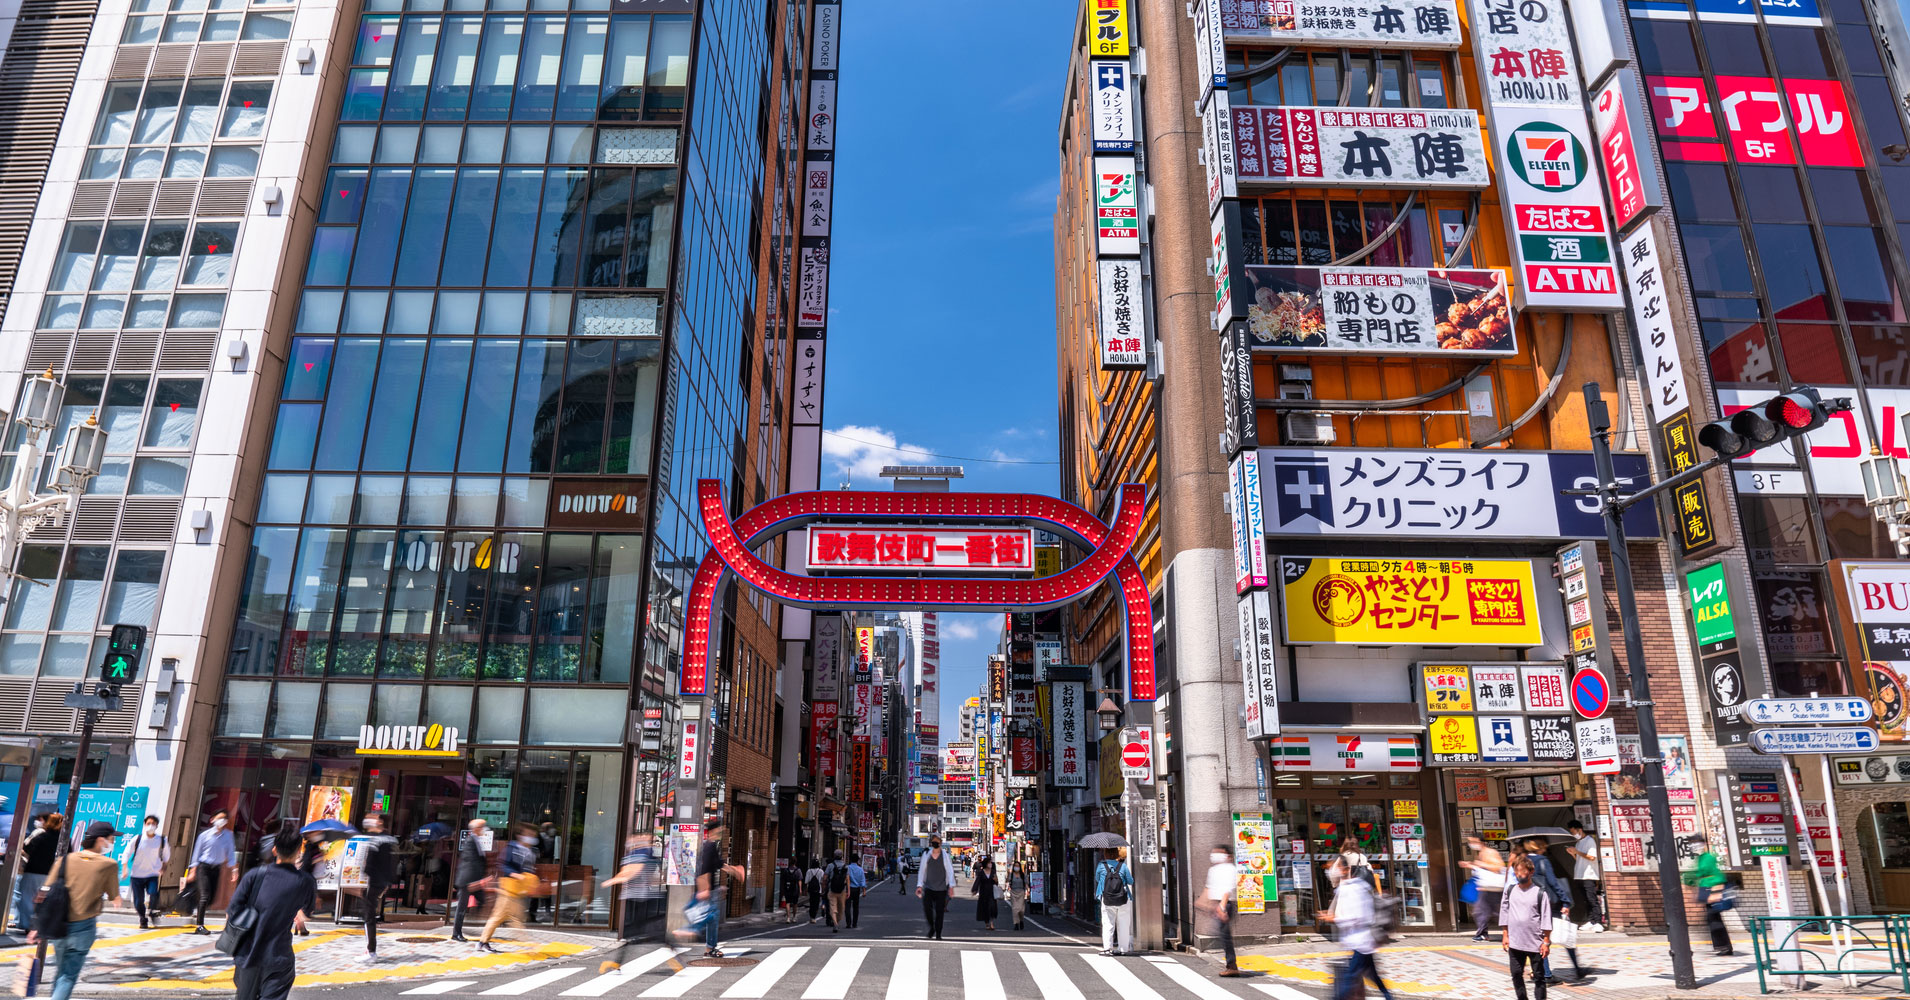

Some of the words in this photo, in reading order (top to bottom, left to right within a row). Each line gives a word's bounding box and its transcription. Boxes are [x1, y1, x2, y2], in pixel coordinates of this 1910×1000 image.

[1222, 15, 1258, 30] 名物
[1301, 5, 1368, 18] お好み焼き
[1371, 5, 1453, 35] 本陣
[819, 8, 831, 39] CASINO
[1301, 18, 1358, 31] 鉄板焼き
[819, 41, 830, 66] POKER
[1099, 42, 1120, 53] 6F
[1490, 46, 1568, 80] 本陣
[1214, 76, 1226, 84] 3F
[1500, 81, 1569, 101] HONJIN
[1101, 92, 1112, 132] クリニック
[1112, 92, 1124, 139] メンズライフ
[1321, 112, 1427, 129] 歌舞伎町名物
[1430, 115, 1473, 129] HONJIN
[1236, 111, 1260, 174] お好み焼
[1266, 112, 1289, 174] たこ焼き
[1293, 111, 1318, 175] もんじゃ焼き
[1744, 139, 1776, 159] 5F
[1340, 131, 1469, 179] 本陣
[1607, 132, 1635, 201] アコム
[808, 199, 826, 227] 魚金
[1104, 208, 1132, 217] たばこ
[1525, 207, 1596, 231] たばこ
[1624, 197, 1638, 218] 3F
[1107, 228, 1131, 237] ATM
[1112, 218, 1124, 228] 酒
[1547, 237, 1582, 261] 酒
[1324, 273, 1405, 286] 歌舞伎町名物
[1535, 267, 1611, 292] ATM
[1112, 265, 1132, 336] お好み焼き
[1334, 291, 1418, 316] 粉もの
[1336, 319, 1425, 346] 専門店
[1630, 237, 1679, 407] 東京ぷらんど
[1107, 339, 1142, 353] 本陣
[1109, 354, 1140, 364] HONJIN
[1242, 400, 1256, 439] スパークル
[1338, 456, 1530, 490] メンズライフ
[558, 493, 639, 514] DOUTOR
[1244, 463, 1263, 539] ファイトフィット
[1342, 496, 1500, 531] クリニック
[1682, 490, 1706, 541] 販売
[817, 532, 1025, 564] 歌舞伎町一番街
[1285, 561, 1305, 577] 2F
[1342, 561, 1380, 573] 営業時間
[1364, 575, 1450, 603] やきとり
[1470, 582, 1519, 600] やきとり
[1692, 579, 1724, 605] レイク
[1369, 604, 1460, 631] センター
[1474, 602, 1521, 620] 専門店
[1696, 601, 1730, 624] ALSA
[1714, 642, 1723, 651] B1
[856, 673, 871, 683] B1F
[1436, 690, 1461, 702] ブル
[1480, 683, 1516, 699] 本陣
[1063, 685, 1076, 743] お好み焼き
[1773, 702, 1845, 713] 大久保病院
[1529, 718, 1560, 730] BUZZ
[1561, 716, 1571, 724] 4F
[358, 723, 459, 752] DOUTOR
[1441, 743, 1468, 752] センター
[1531, 730, 1569, 742] STAND
[684, 723, 697, 774] 劇場通り
[1063, 746, 1078, 776] 本陣
[1391, 826, 1412, 835] たばこ
